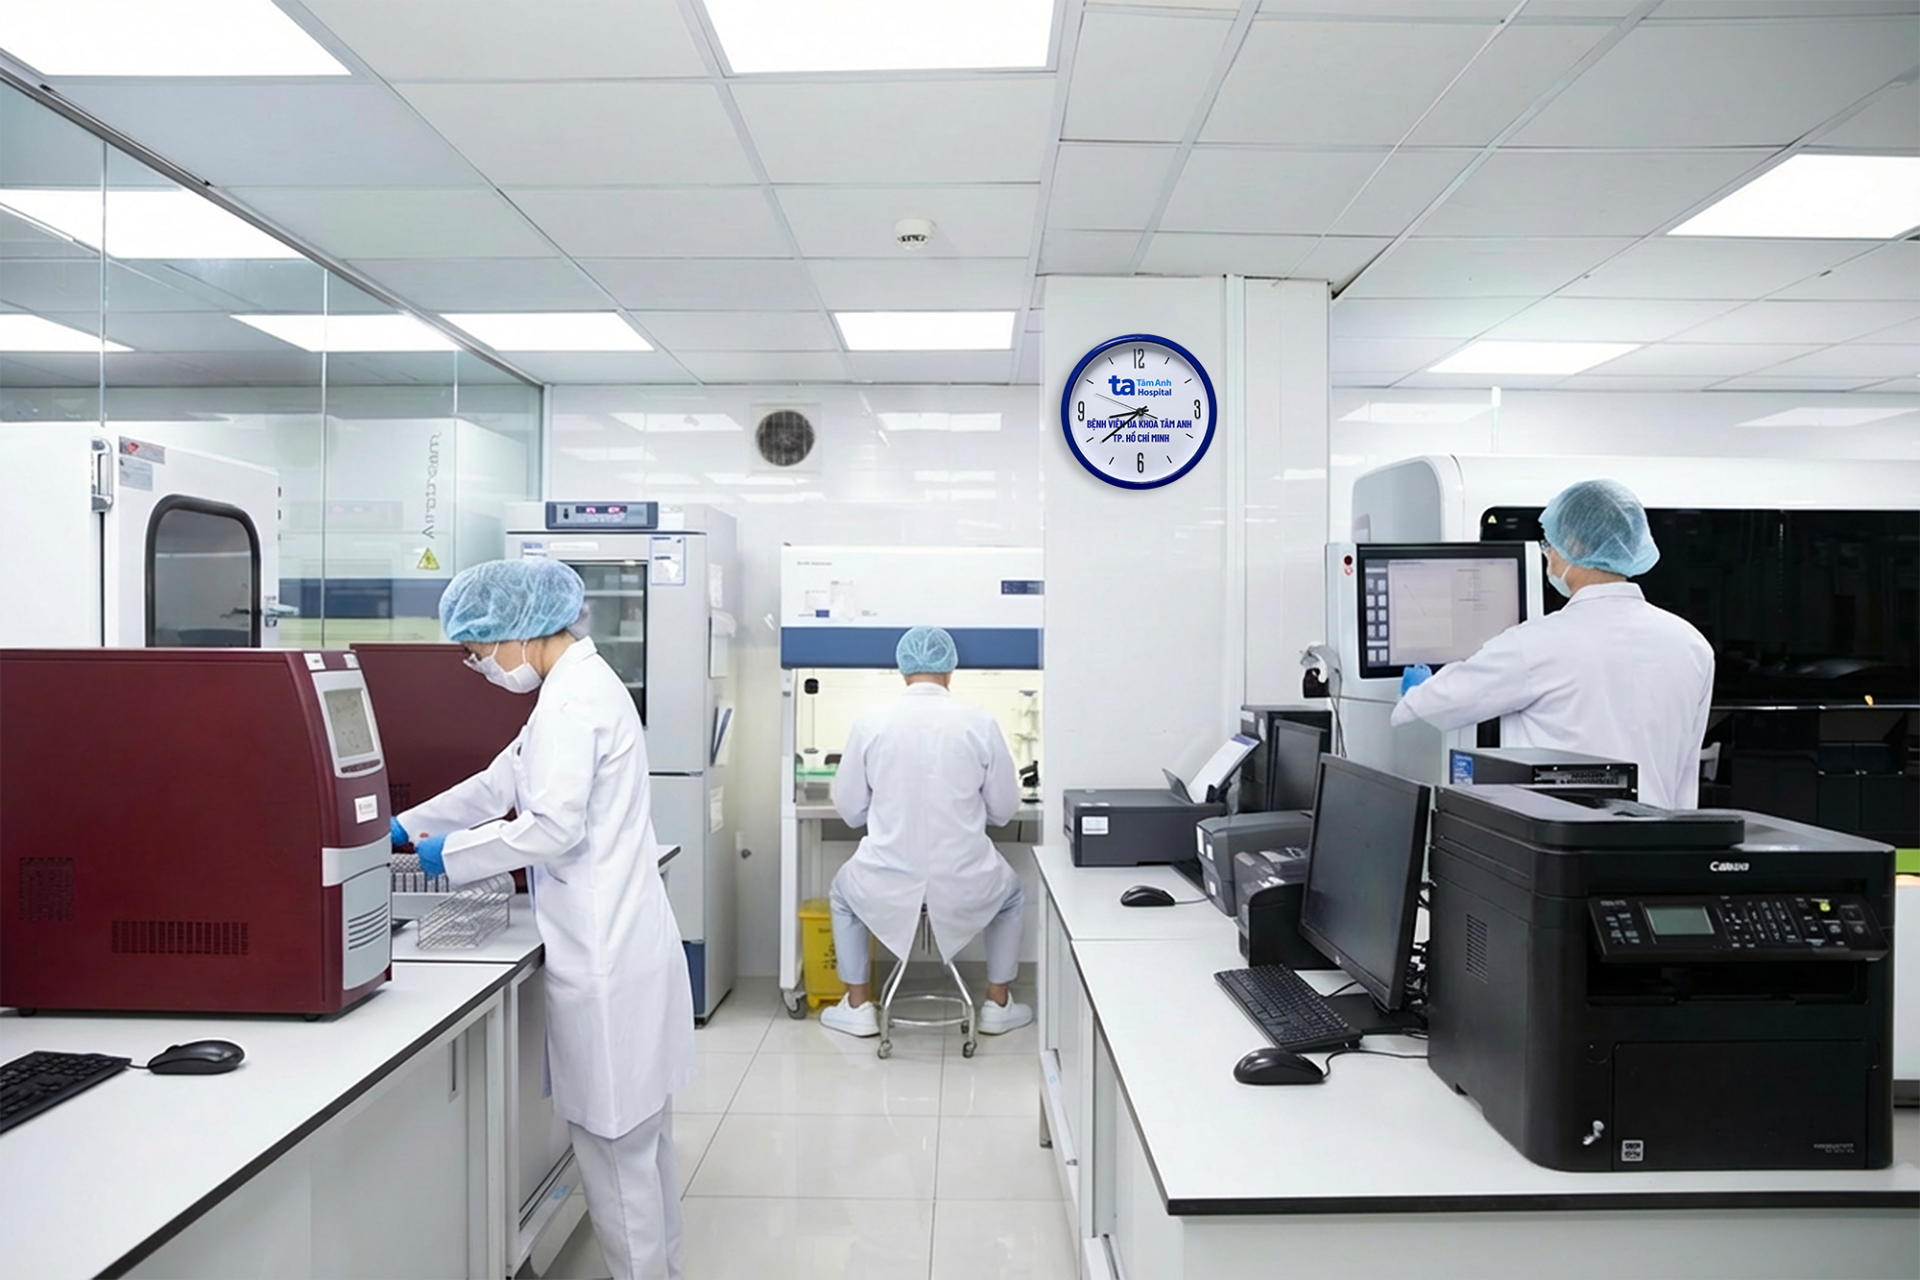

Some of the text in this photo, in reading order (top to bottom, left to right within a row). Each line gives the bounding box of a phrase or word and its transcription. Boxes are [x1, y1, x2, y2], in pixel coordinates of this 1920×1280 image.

[1133, 348, 1145, 369] 12
[1108, 375, 1136, 396] ta
[1154, 378, 1172, 387] Anh
[1137, 388, 1172, 398] Hospital
[1077, 401, 1085, 421] 9
[1194, 399, 1201, 420] 3
[1086, 417, 1107, 431] BỆNH
[1139, 419, 1159, 429] KHOA
[1160, 417, 1175, 429] TÂM
[1176, 419, 1192, 429] ANH
[1113, 433, 1125, 443] TP.
[1137, 431, 1150, 443] CHÍ
[1151, 433, 1170, 443] MINH
[1137, 452, 1144, 474] 6
